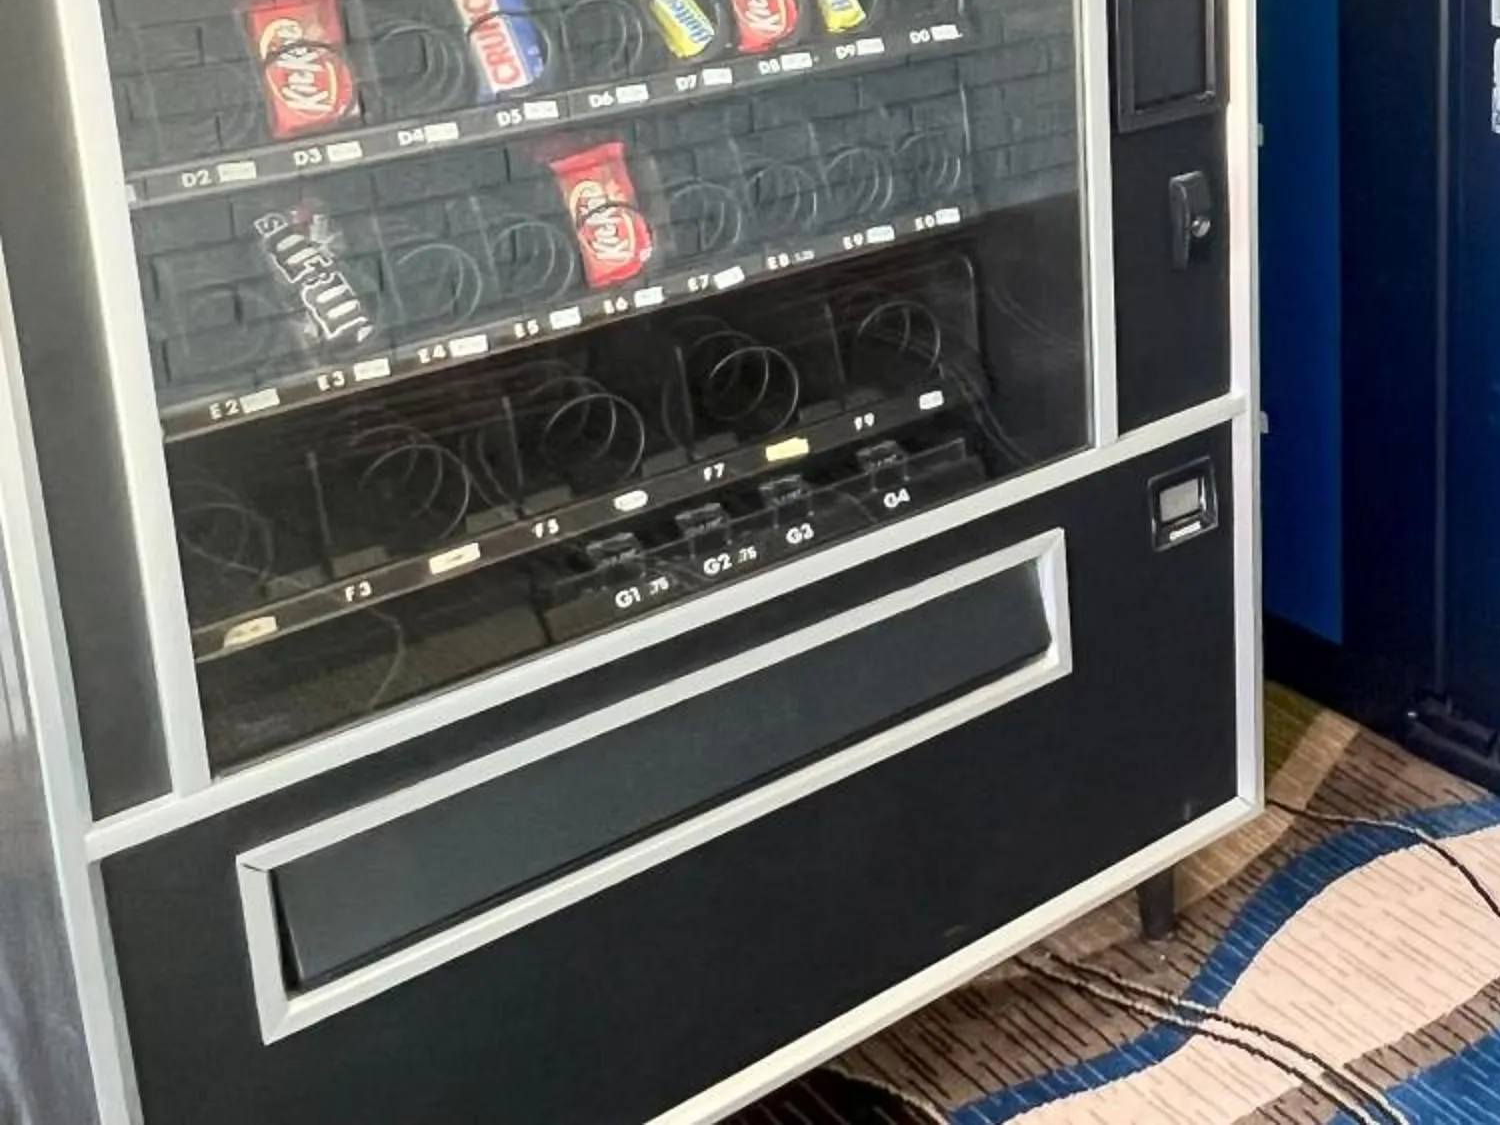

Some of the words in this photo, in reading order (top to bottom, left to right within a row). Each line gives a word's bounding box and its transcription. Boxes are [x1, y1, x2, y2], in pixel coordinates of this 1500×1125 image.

[758, 58, 781, 75] D8
[675, 75, 698, 92] D7
[588, 93, 614, 109] D6
[495, 108, 522, 125] D5
[397, 127, 425, 146] D4
[293, 147, 323, 166] D3
[181, 169, 212, 188] D2
[513, 318, 540, 339] E5
[416, 342, 447, 365] E4
[316, 369, 346, 392] E3
[208, 399, 241, 420] E2
[883, 487, 911, 509] G4
[785, 522, 815, 545] G3
[703, 552, 733, 576] G2
[344, 580, 373, 602] F3
[614, 585, 642, 609] G1
